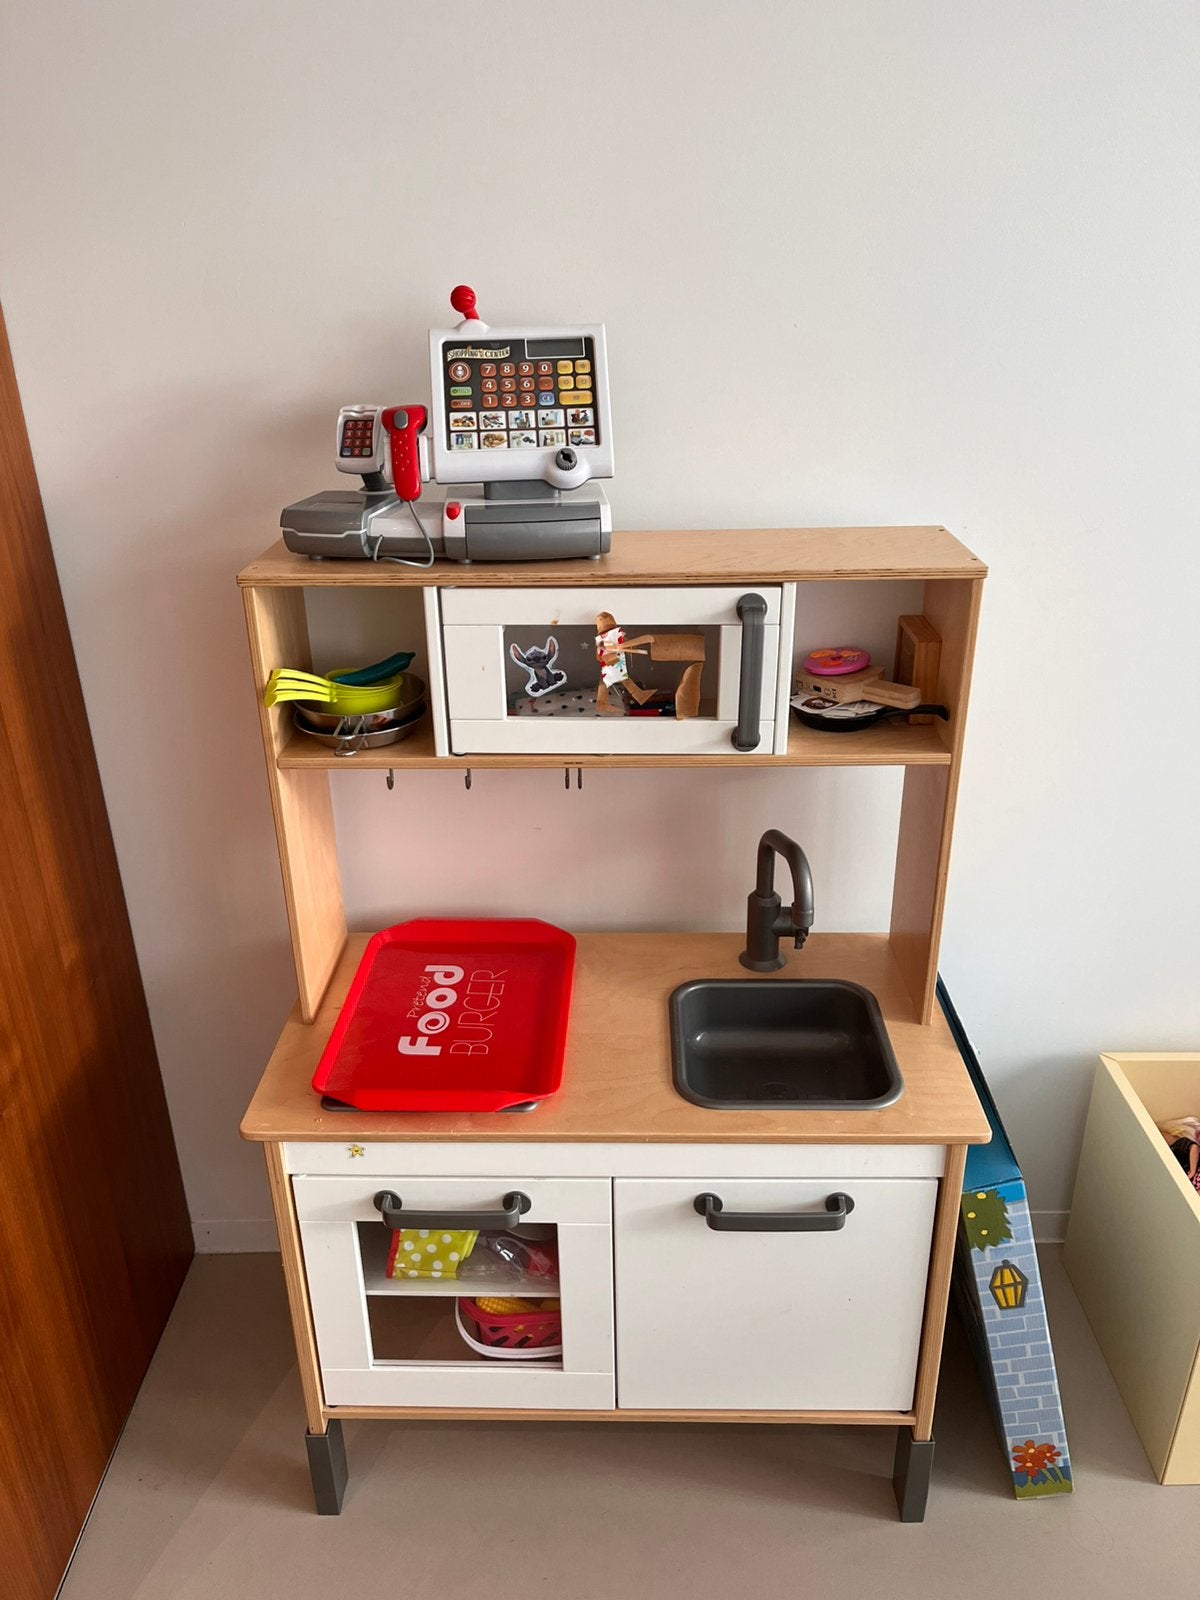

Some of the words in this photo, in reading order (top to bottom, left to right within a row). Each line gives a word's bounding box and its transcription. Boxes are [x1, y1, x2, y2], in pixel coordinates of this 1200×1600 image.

[484, 366, 491, 374] 7
[503, 365, 511, 373] 8
[522, 364, 529, 372] 9
[541, 364, 548, 372] 0
[485, 381, 492, 389] 4
[504, 381, 511, 389] 5
[523, 380, 530, 388] 6
[487, 397, 492, 405] 1
[505, 396, 512, 404] 2
[449, 969, 508, 1056] BURGER
